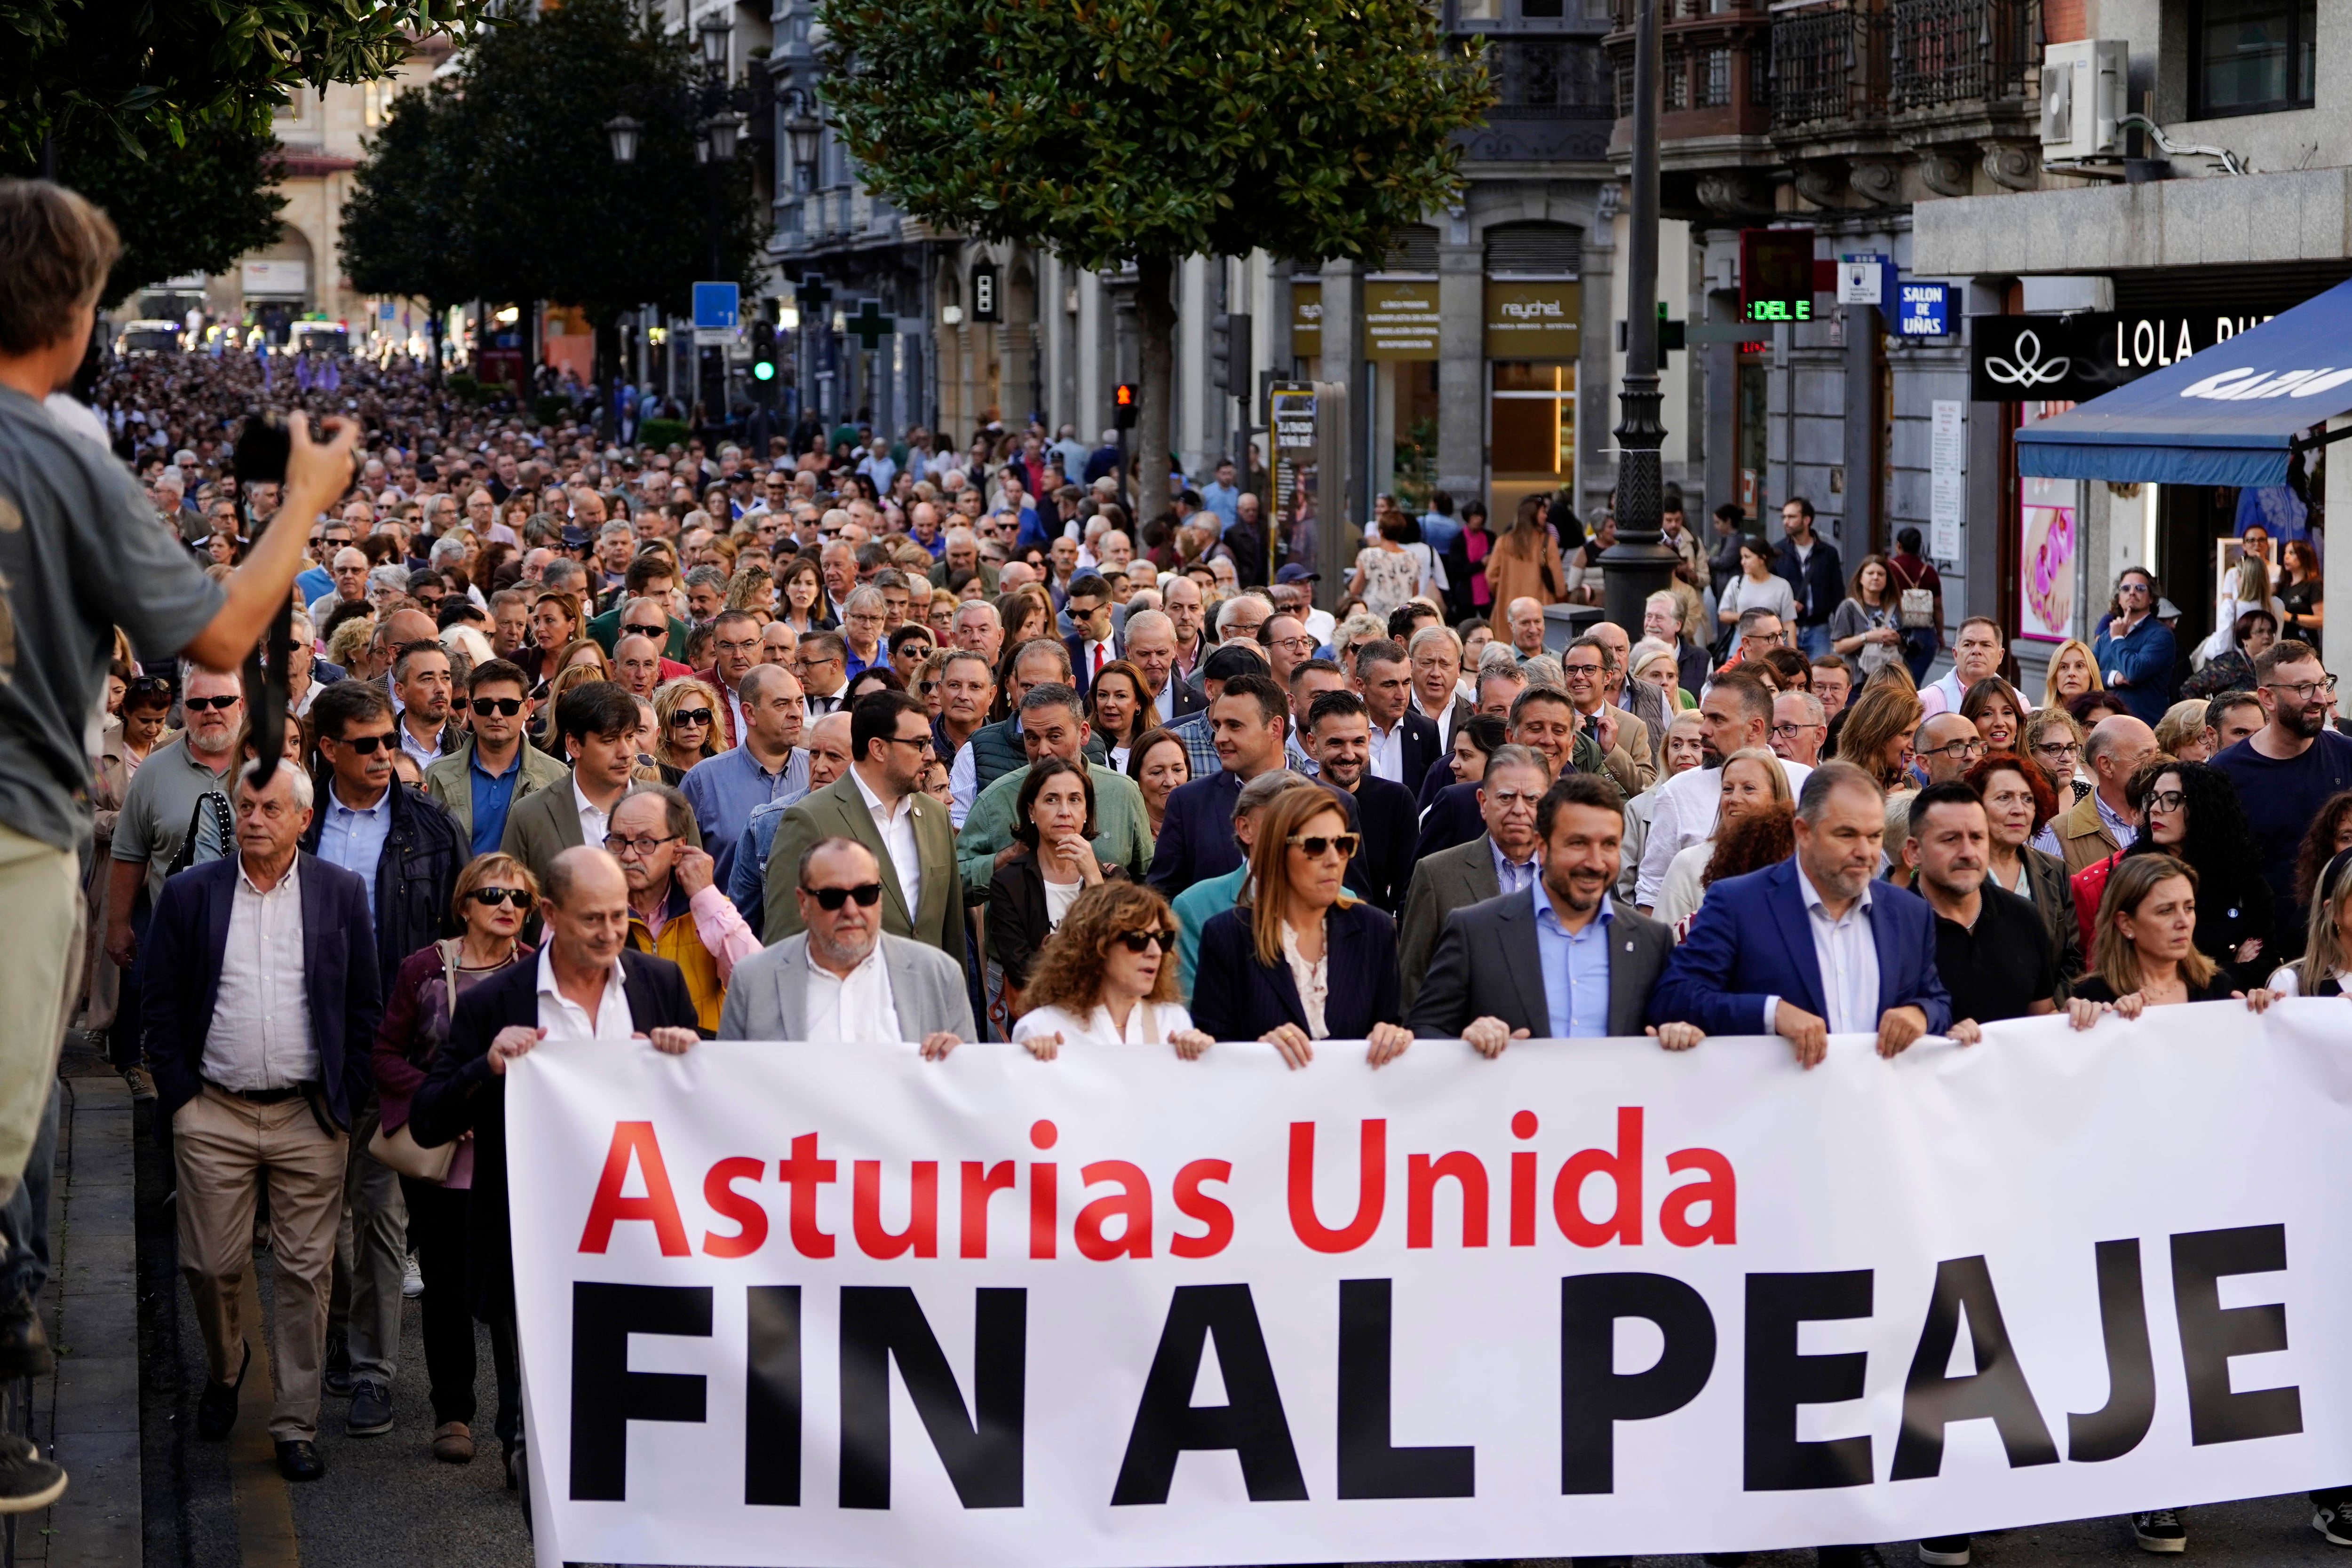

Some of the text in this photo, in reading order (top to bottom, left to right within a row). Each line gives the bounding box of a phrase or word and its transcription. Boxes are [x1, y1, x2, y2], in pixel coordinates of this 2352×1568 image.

[1903, 287, 1942, 302] SALON
[1915, 302, 1930, 316] DE
[1903, 316, 1941, 334] UÑAS
[2117, 318, 2193, 367] LOLA
[578, 1107, 1737, 1261] Asturias Unida
[570, 1224, 2303, 1510] FIN AL PEAJE
